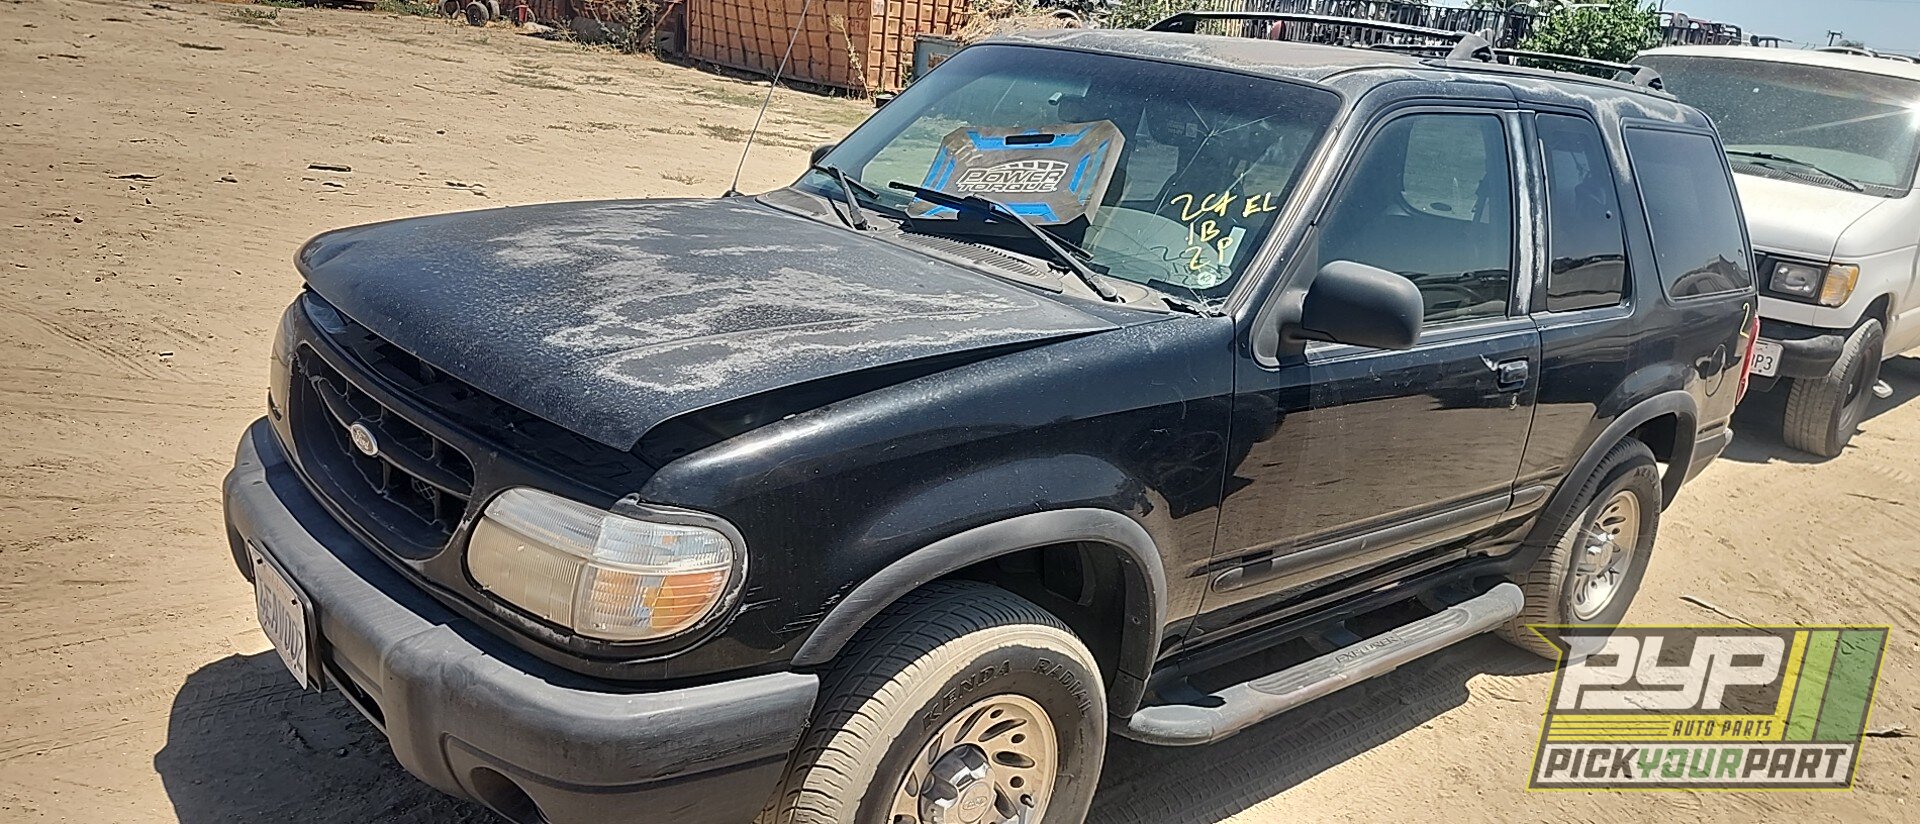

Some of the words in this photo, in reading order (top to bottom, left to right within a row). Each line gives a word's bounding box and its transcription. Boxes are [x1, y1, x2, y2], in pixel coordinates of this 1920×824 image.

[957, 168, 1065, 184] POWER
[1242, 192, 1277, 218] EL
[920, 659, 1013, 732] KENDA
[1033, 657, 1094, 719] RADIAL
